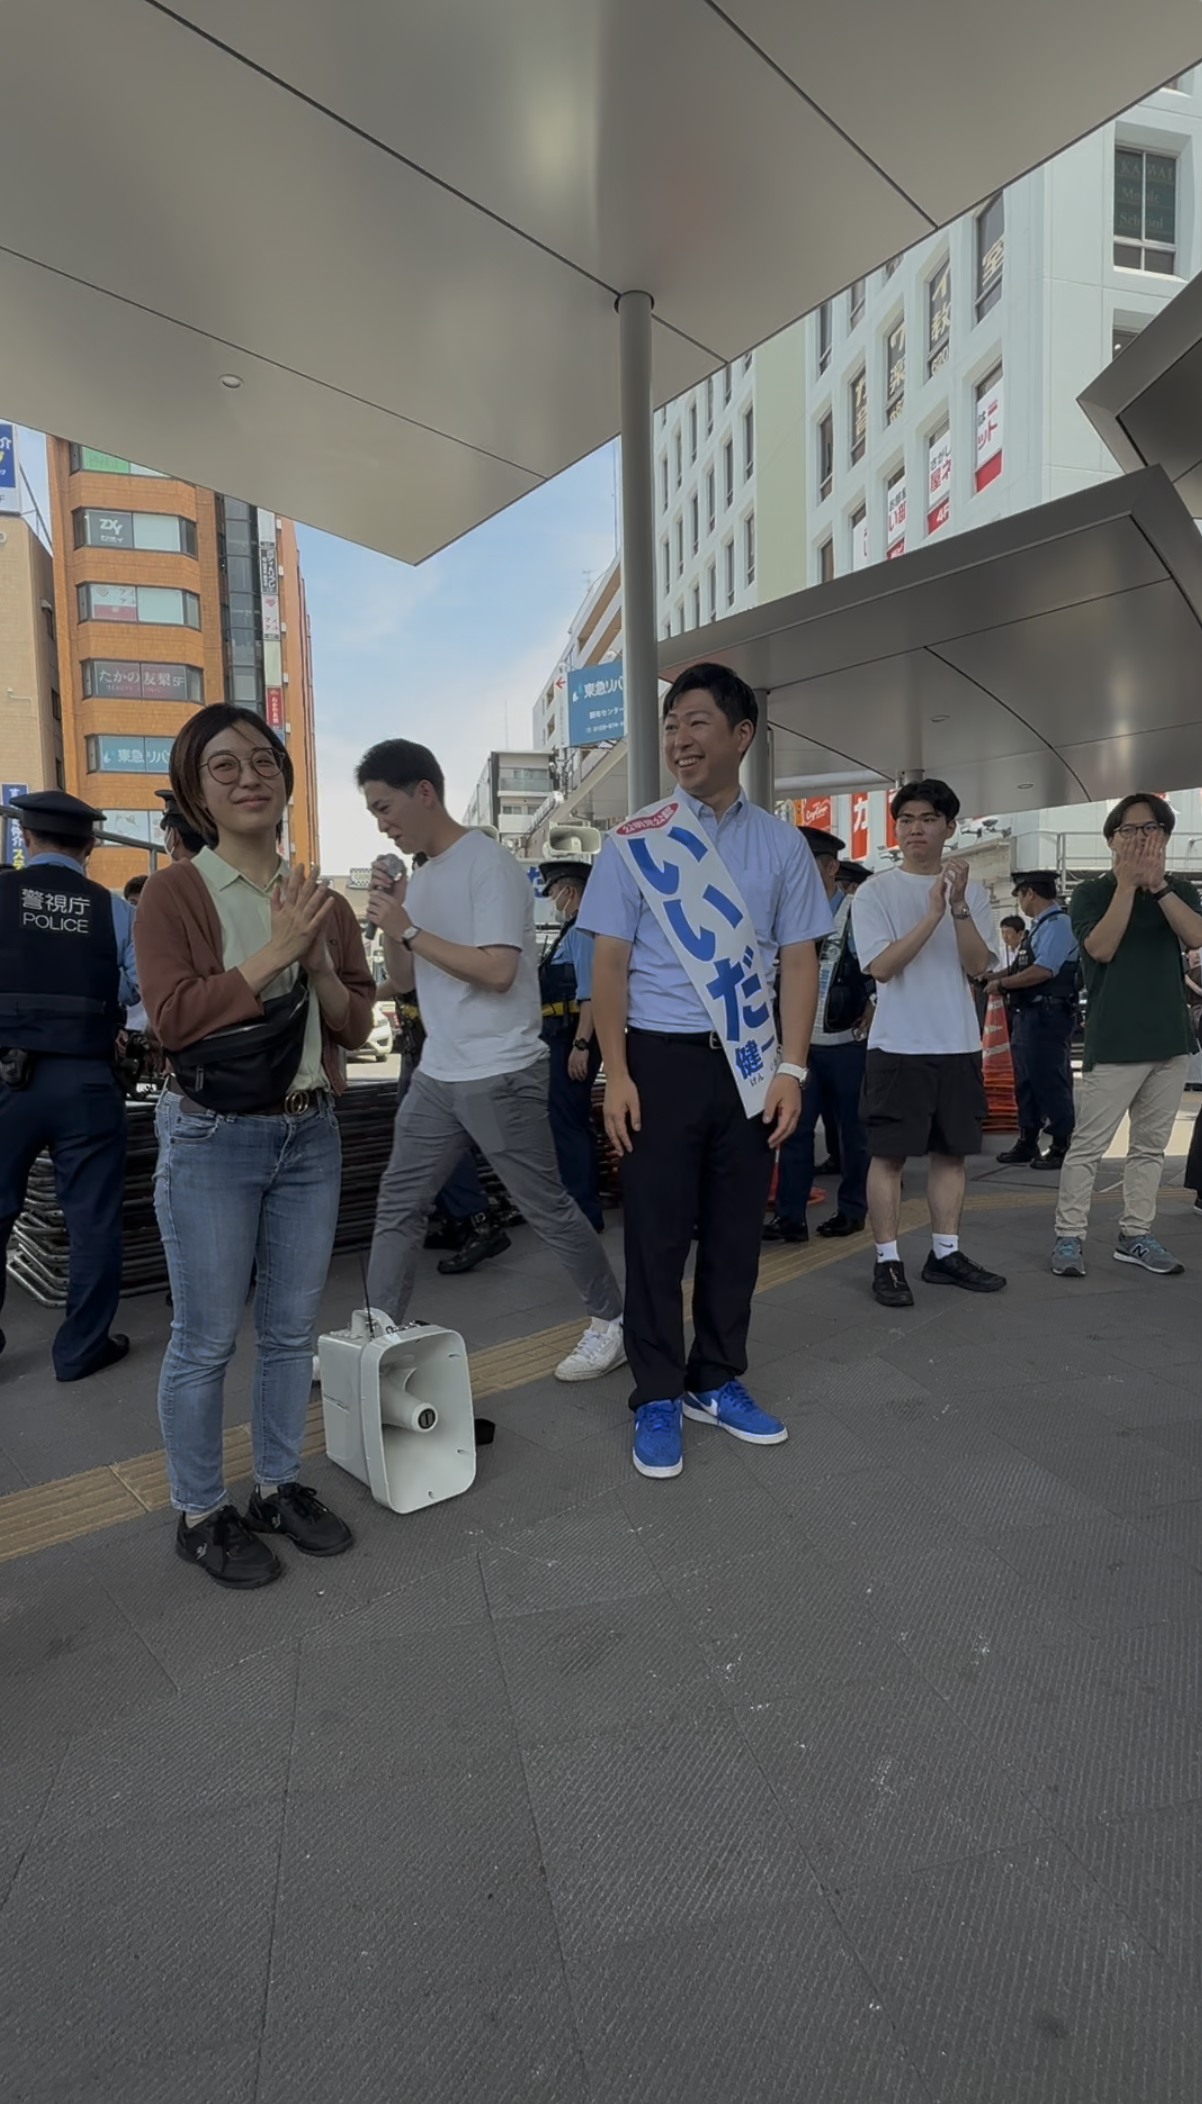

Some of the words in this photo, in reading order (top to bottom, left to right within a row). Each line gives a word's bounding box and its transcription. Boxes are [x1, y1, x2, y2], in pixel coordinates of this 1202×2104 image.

[1122, 186, 1160, 204] Muic
[99, 518, 122, 535] ZXY
[21, 888, 91, 915] 警視庁
[23, 911, 89, 934] POLICE
